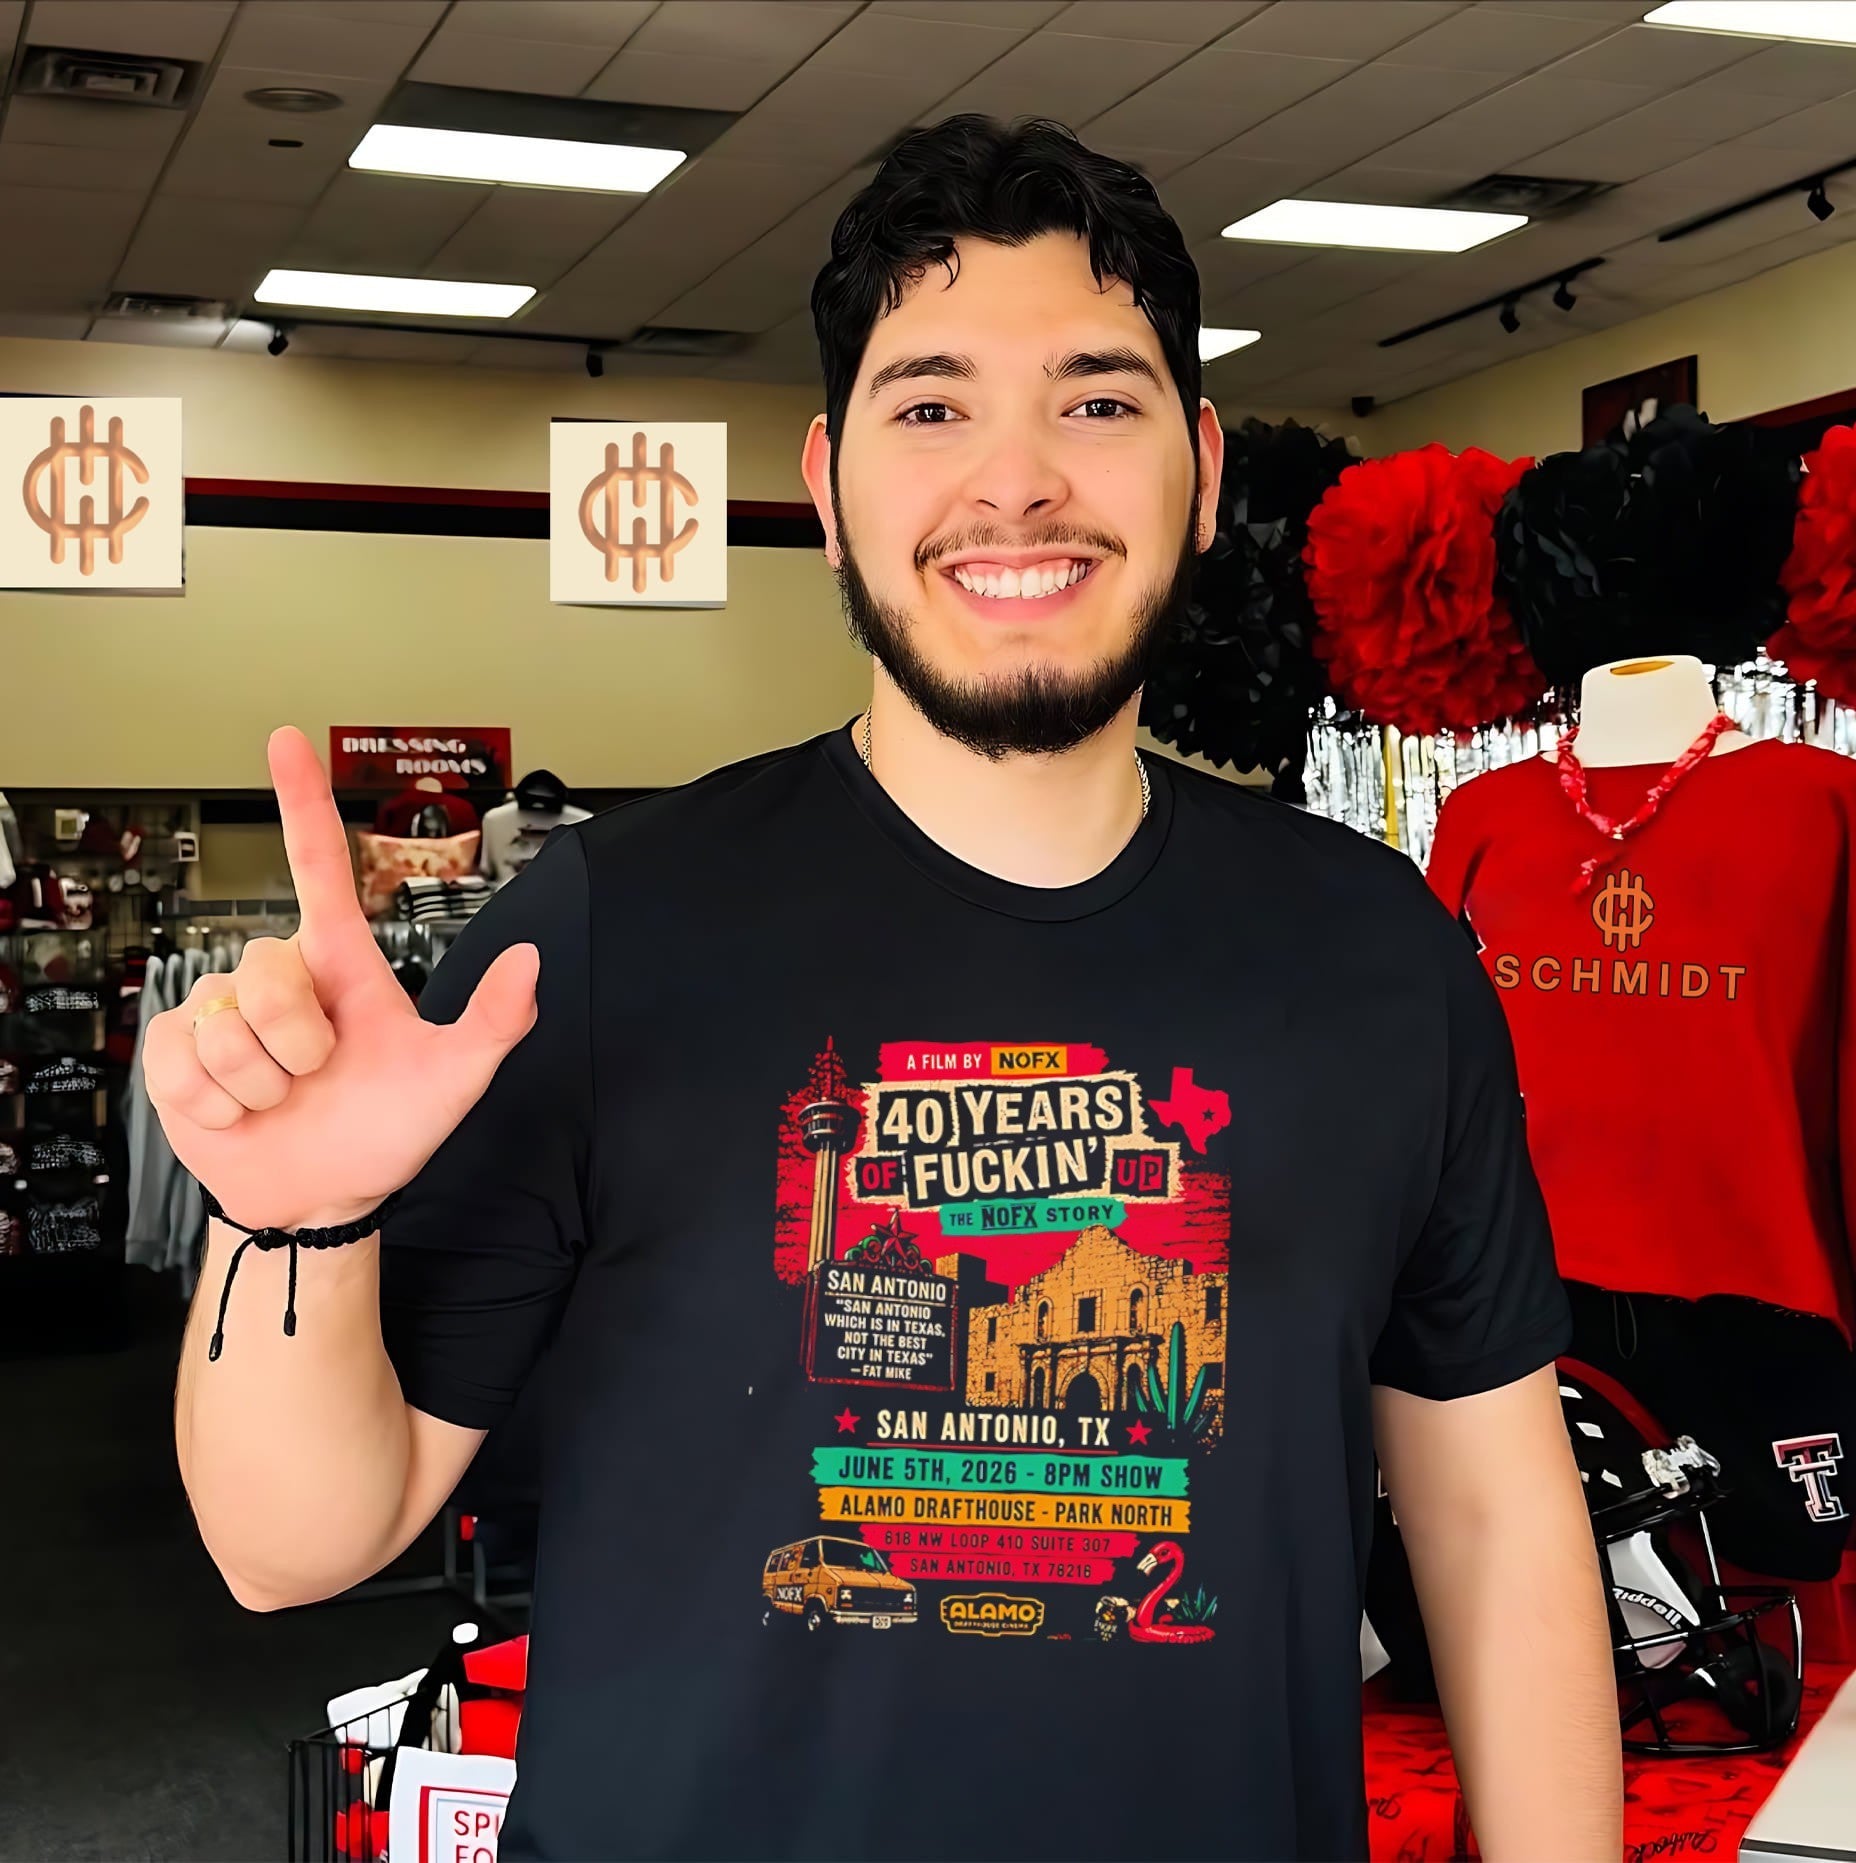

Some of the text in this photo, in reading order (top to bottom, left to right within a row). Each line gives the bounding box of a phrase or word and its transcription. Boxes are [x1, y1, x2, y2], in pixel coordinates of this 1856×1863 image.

[396, 758, 487, 775] ROOMS
[1494, 953, 1747, 1001] SCHMIDT
[907, 1051, 1061, 1071] A FILM BY NOFX
[882, 1084, 1125, 1145] 40 YEARS
[861, 1136, 1162, 1200] OF FUCKIN’ UP
[948, 1204, 1114, 1228] THE NOFX STORY
[827, 1269, 947, 1302] SAN ANTONIO
[875, 1302, 932, 1320] ANTONIO
[824, 1313, 867, 1330] WHICH
[870, 1317, 884, 1331] IS
[886, 1319, 900, 1333] IN
[844, 1331, 928, 1351] NOT THE BEST
[837, 1345, 866, 1361] CITY
[869, 1348, 883, 1363] IN
[885, 1366, 912, 1381] MIKE
[876, 1409, 1111, 1448] SAN ANTONIO, TX
[838, 1455, 895, 1481] JUNE
[903, 1457, 951, 1486] 5TH,
[961, 1460, 1018, 1485] 2026
[1044, 1463, 1091, 1488] 8PM
[1101, 1465, 1164, 1491] SHOW
[839, 1494, 905, 1518] ALAMO
[914, 1497, 1036, 1523] DRAFTHOUSE
[1055, 1502, 1103, 1525] PARK
[1111, 1504, 1173, 1527] NORTH
[918, 1532, 943, 1548] NW
[950, 1533, 990, 1549] LOOP
[996, 1535, 1024, 1550] 410
[1031, 1536, 1075, 1552] SUITE
[1082, 1537, 1112, 1553] 307
[910, 1558, 1093, 1578] SAN ANTONIO, TX 78216
[776, 1586, 803, 1603] NOFX
[950, 1602, 1037, 1623] ALAMO
